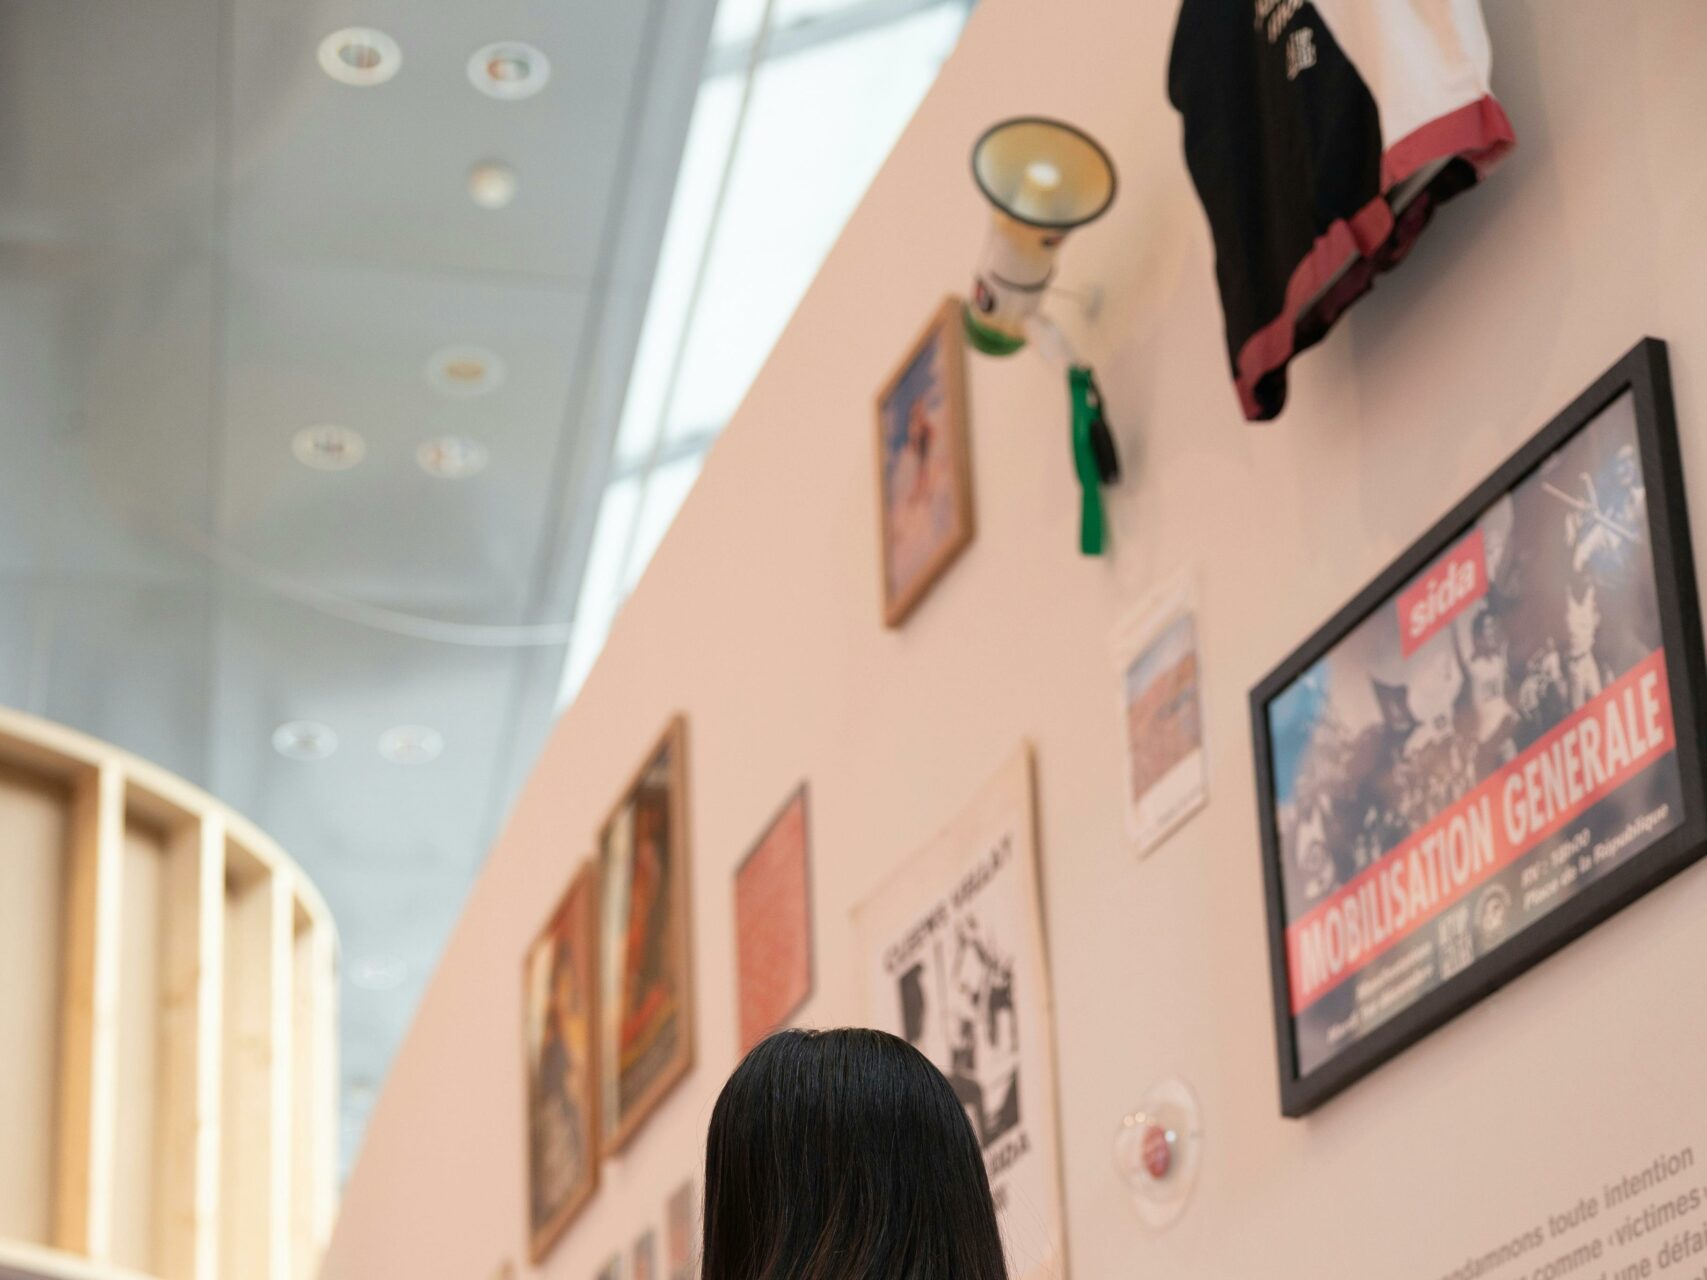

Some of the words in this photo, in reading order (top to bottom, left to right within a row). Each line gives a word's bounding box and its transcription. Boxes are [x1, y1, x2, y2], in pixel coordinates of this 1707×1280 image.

[1410, 559, 1475, 638] sida
[1299, 794, 1496, 998] MOBILISATION
[1502, 669, 1666, 848] GENERALE
[1548, 1196, 1598, 1238] toute
[1603, 1146, 1694, 1209] intention
